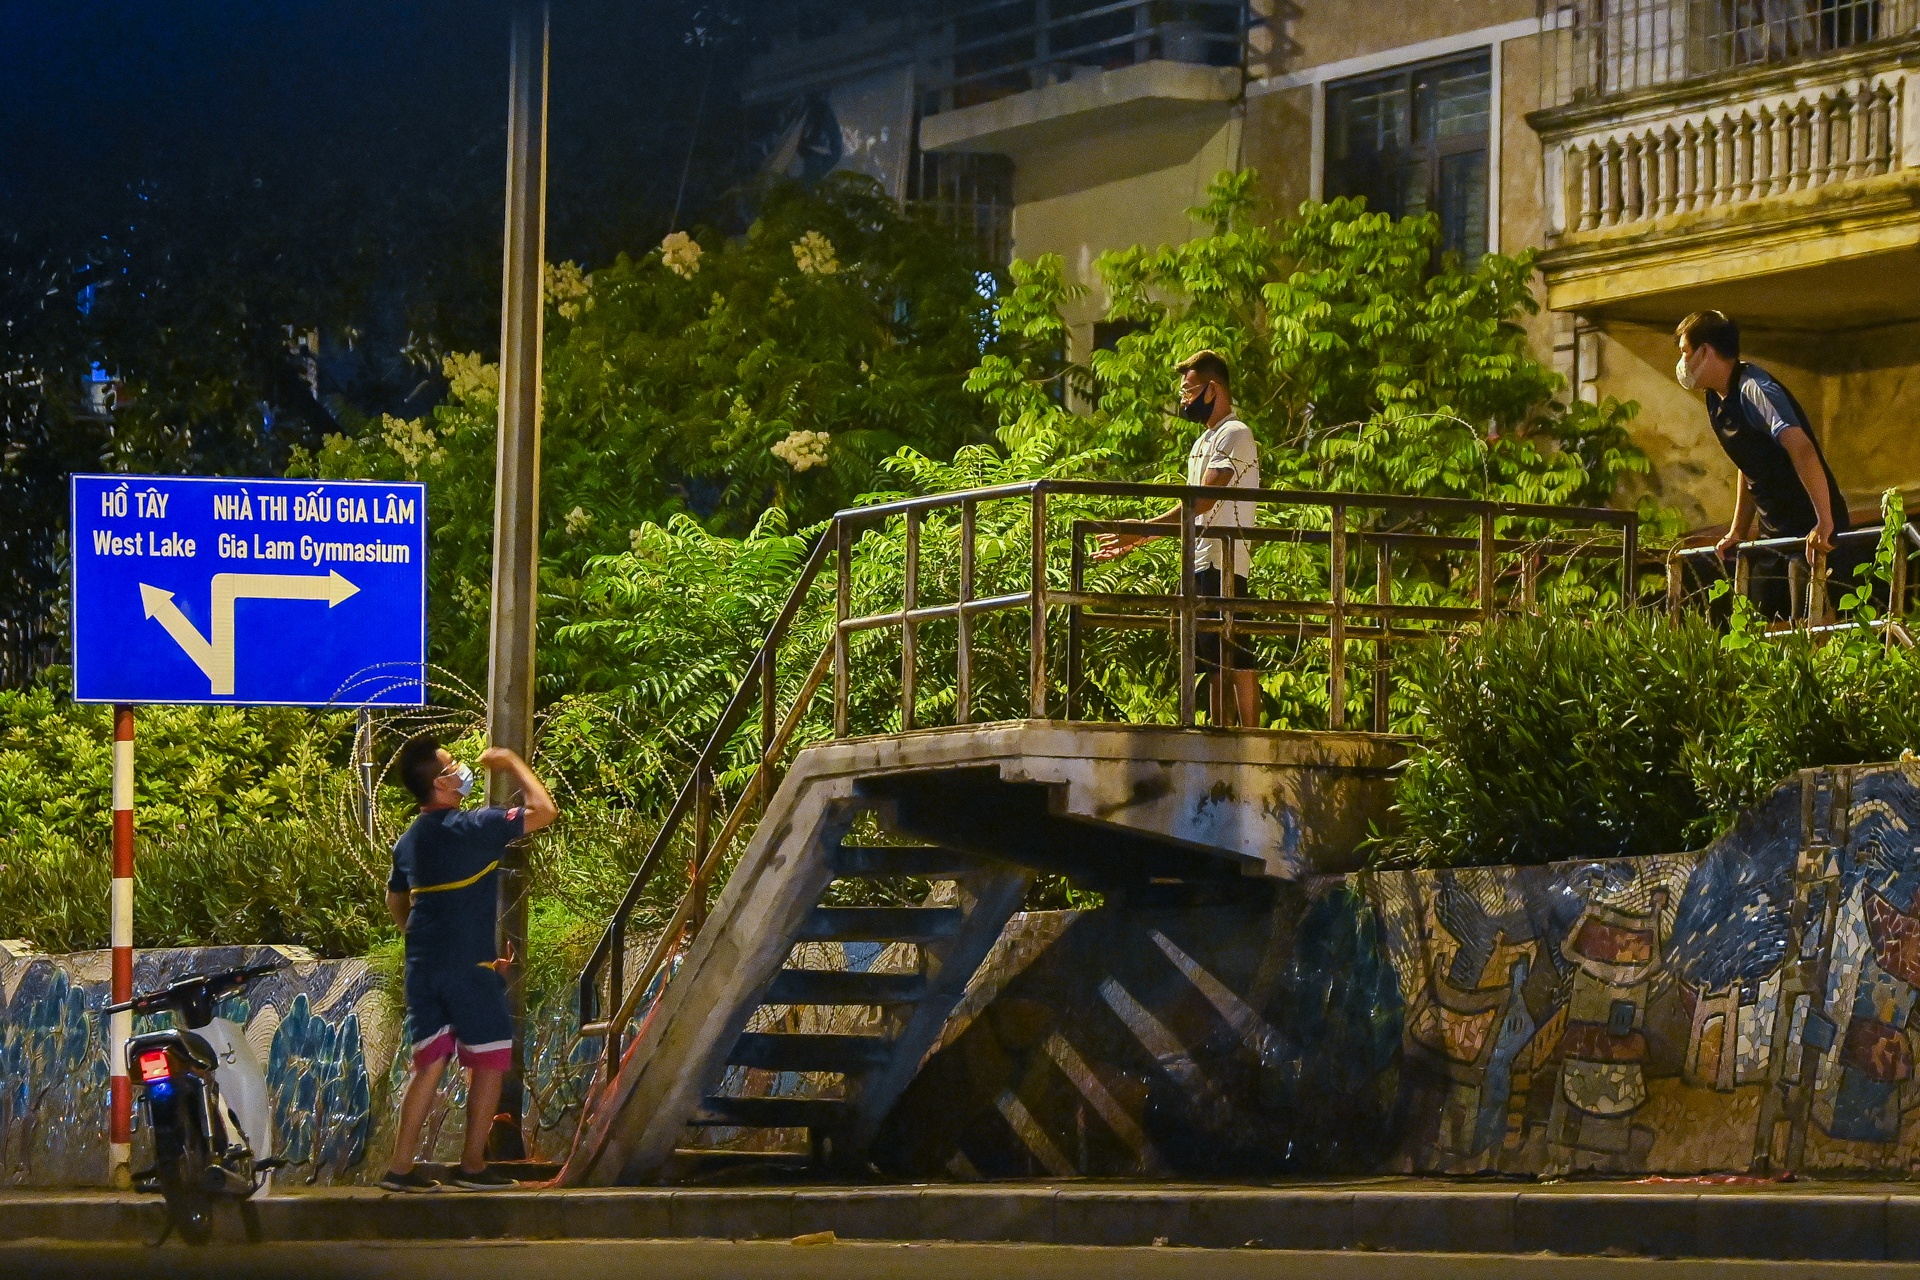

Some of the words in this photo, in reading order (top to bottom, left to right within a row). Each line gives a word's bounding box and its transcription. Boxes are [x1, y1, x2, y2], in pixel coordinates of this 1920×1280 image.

[102, 482, 129, 517] HỒ
[135, 487, 169, 518] TÂY
[214, 488, 253, 520] NHÀ
[258, 496, 287, 521] THI
[293, 487, 331, 522] ĐẤU
[337, 497, 368, 523] GIA
[374, 493, 414, 524] LÂM
[93, 530, 143, 556] West
[150, 531, 196, 557] Lake
[219, 533, 247, 558] Gia
[254, 534, 294, 560] Lam
[301, 535, 409, 566] Gymnasium
